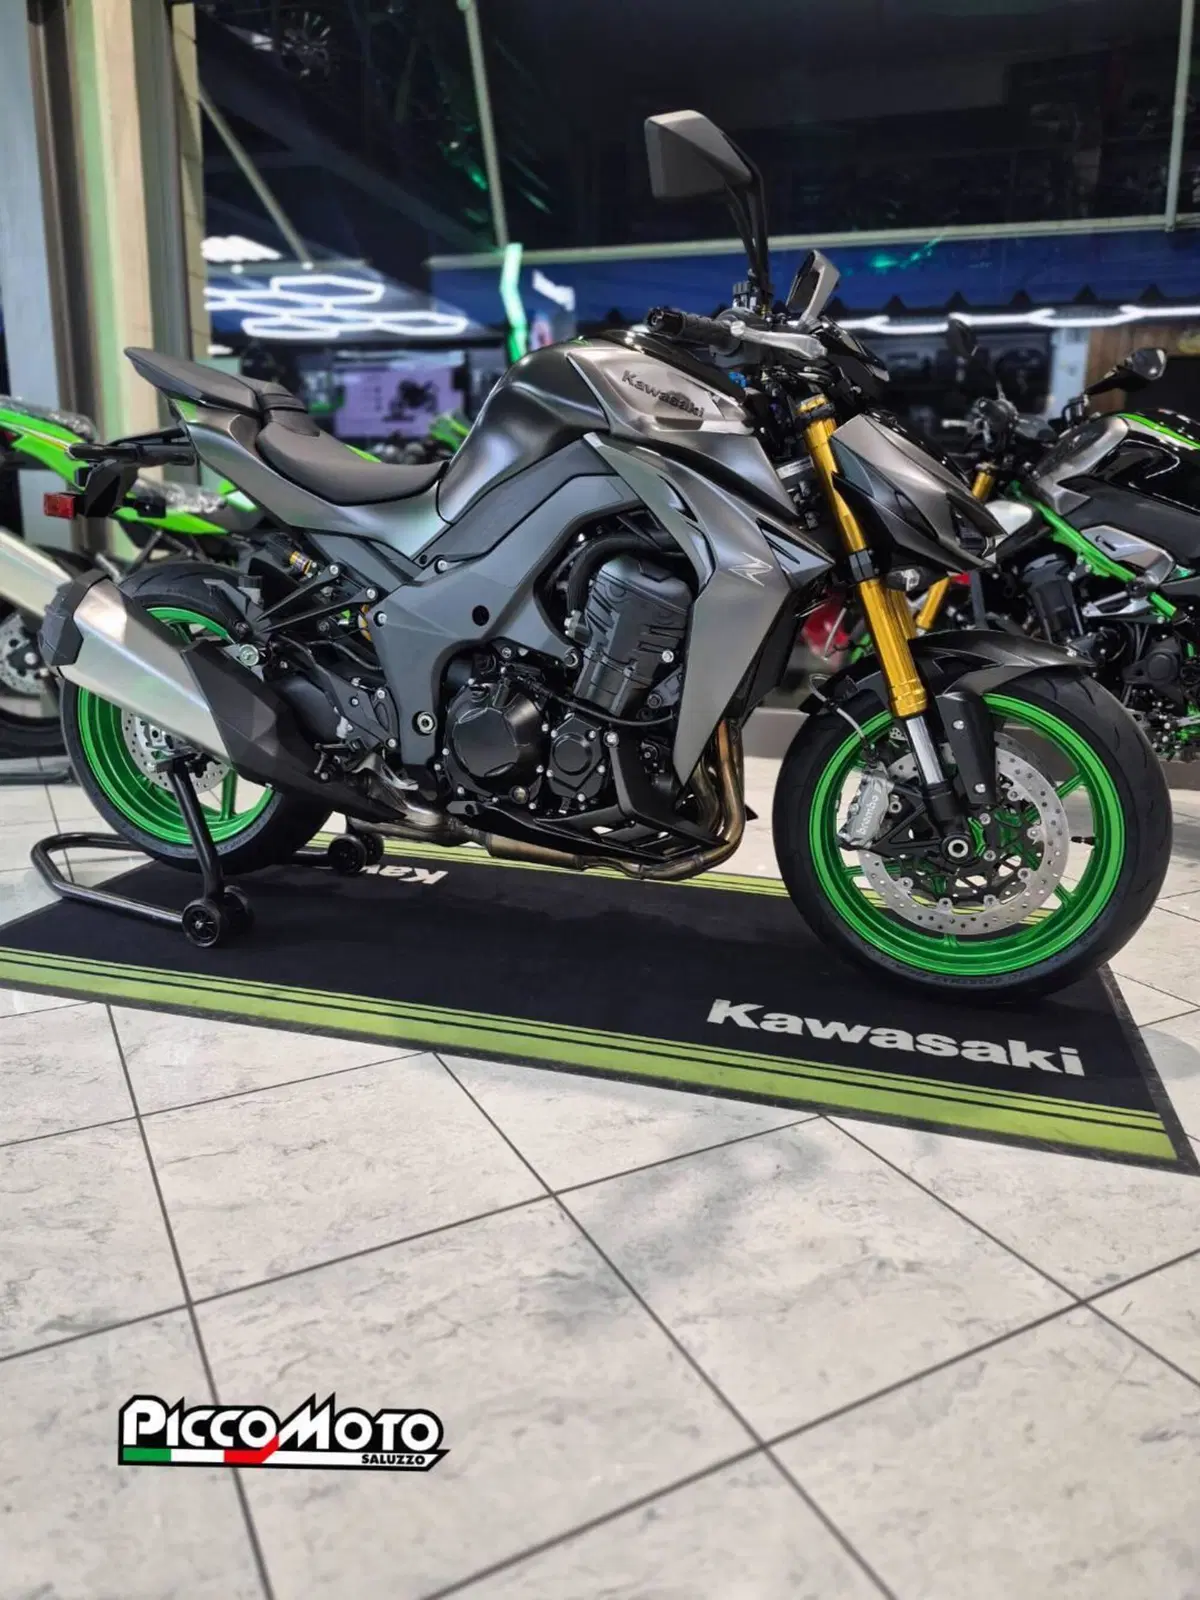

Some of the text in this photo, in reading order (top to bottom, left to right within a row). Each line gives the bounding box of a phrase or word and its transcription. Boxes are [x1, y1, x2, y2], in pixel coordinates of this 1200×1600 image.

[621, 370, 705, 417] Kawasaki
[855, 794, 879, 835] brembo
[706, 998, 1085, 1077] Kawasaki
